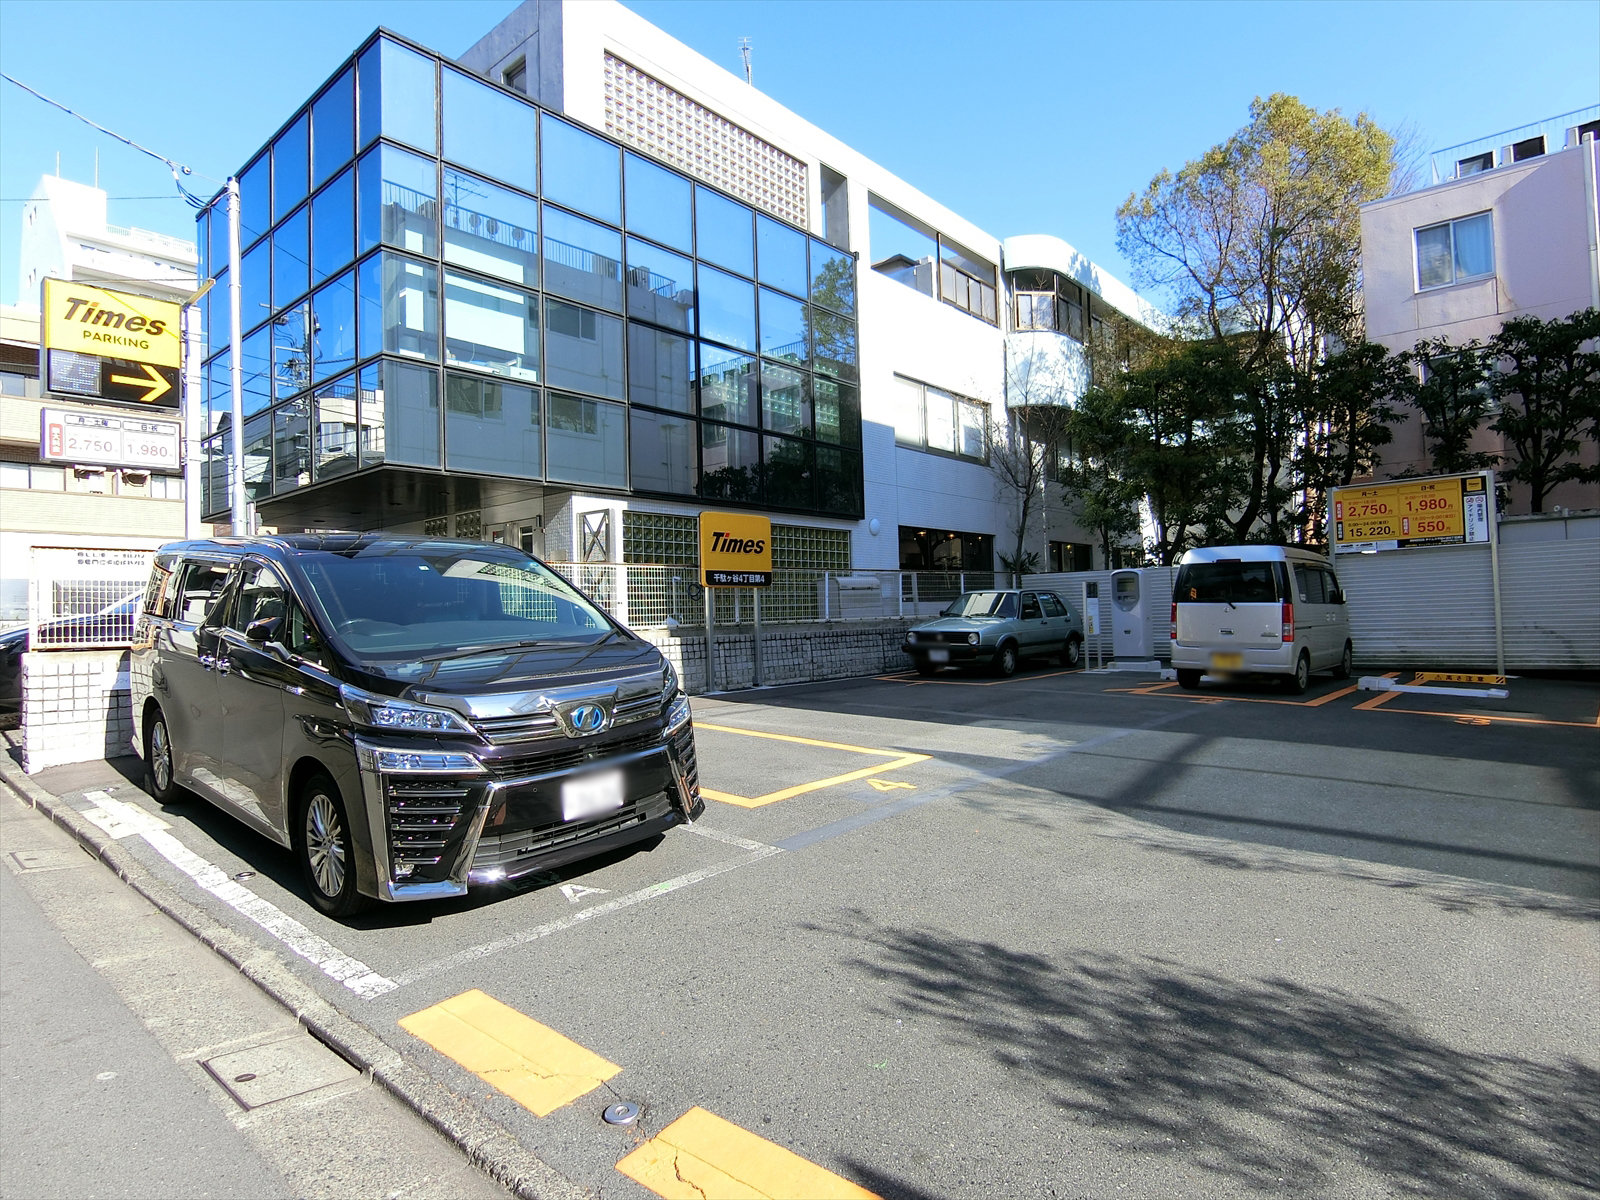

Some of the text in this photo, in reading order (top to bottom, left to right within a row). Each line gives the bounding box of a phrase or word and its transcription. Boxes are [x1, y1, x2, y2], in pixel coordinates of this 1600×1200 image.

[64, 297, 167, 336] Times
[83, 330, 149, 350] PARKING
[711, 531, 766, 554] Times
[713, 573, 765, 583] 千駄ヶ谷4丁目第4
